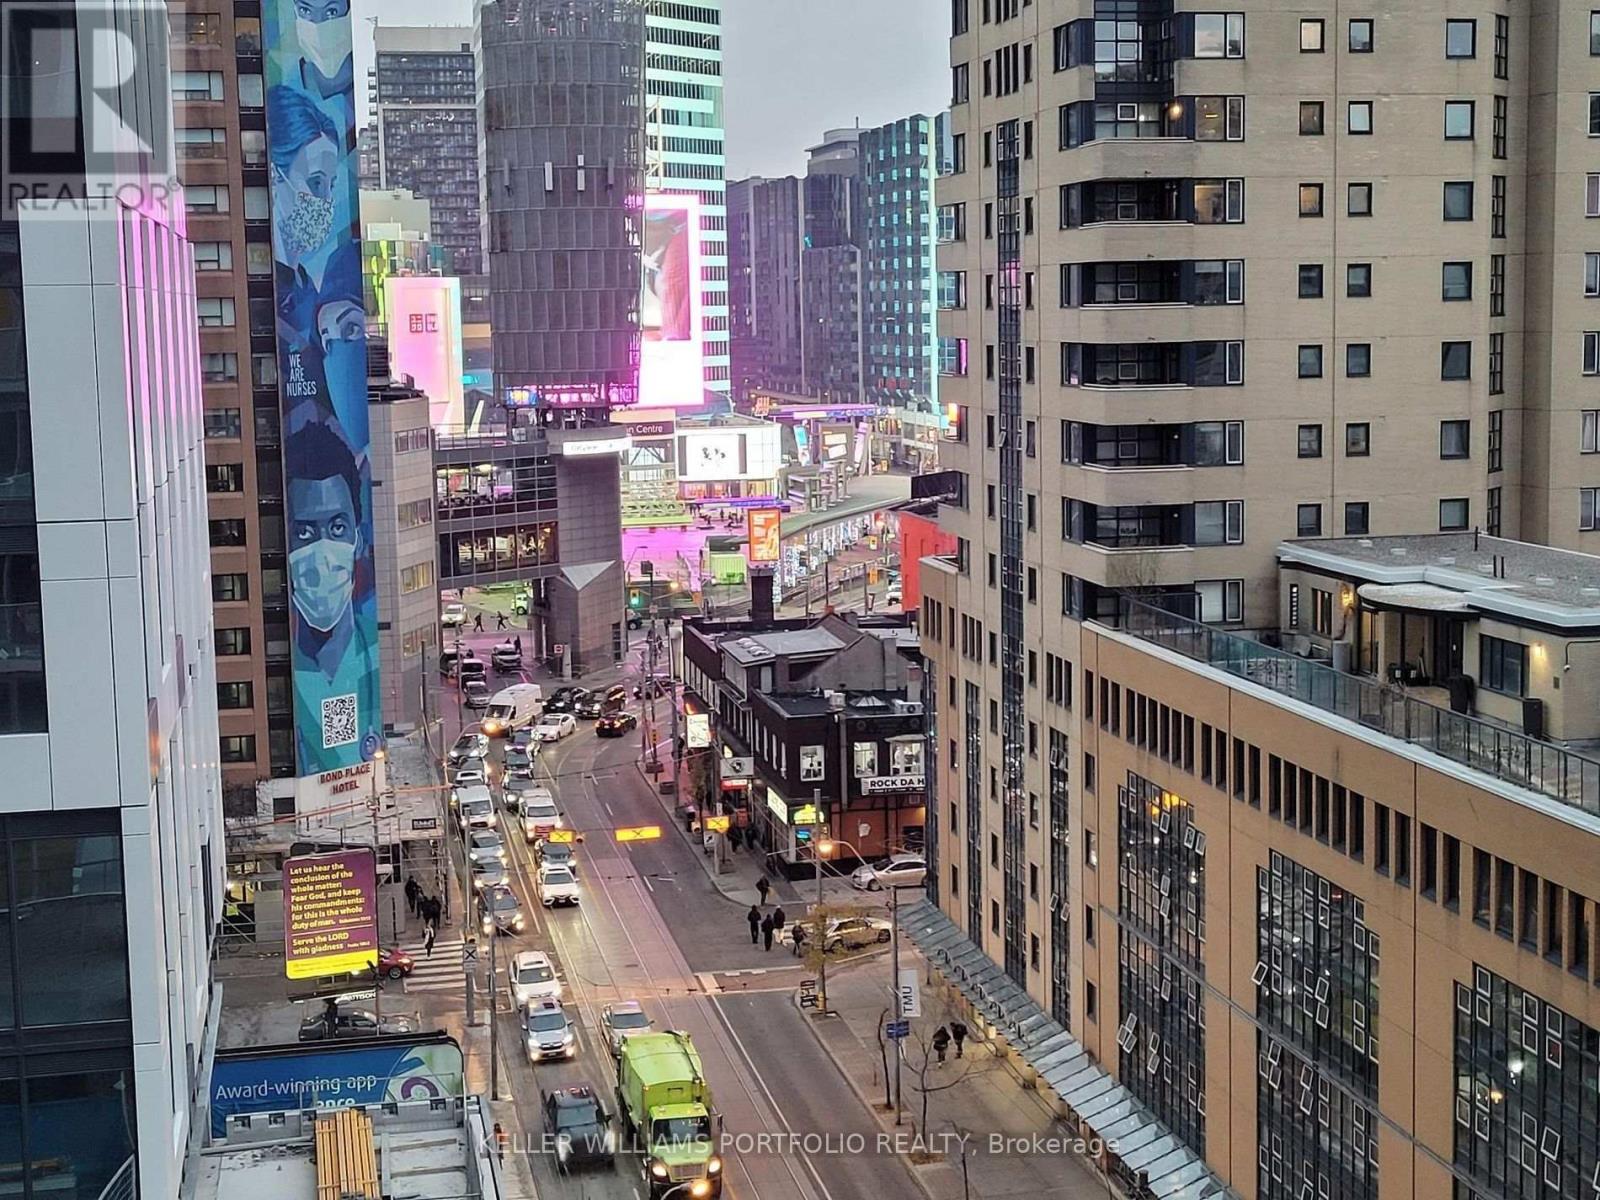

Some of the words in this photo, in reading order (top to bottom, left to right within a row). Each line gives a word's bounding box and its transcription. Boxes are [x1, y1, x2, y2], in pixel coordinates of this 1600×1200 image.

[289, 354, 301, 368] WE
[290, 367, 305, 382] ARE
[287, 381, 317, 397] NURSES
[636, 424, 664, 434] Centre
[320, 770, 343, 784] BOND
[345, 763, 371, 777] PLACE
[332, 780, 360, 795] HOTEL
[870, 779, 898, 787] ROCK
[900, 778, 915, 786] DA
[290, 867, 302, 875] Let
[313, 864, 330, 872] hear
[332, 862, 344, 870] the
[290, 873, 330, 884] conclusion
[331, 872, 340, 880] of
[340, 870, 353, 879] the
[291, 885, 314, 893] whole
[291, 894, 307, 902] Fear
[328, 890, 342, 898] and
[343, 888, 361, 898] keep
[291, 903, 302, 912] his
[292, 912, 303, 921] for
[304, 911, 318, 919] this
[326, 908, 339, 916] the
[340, 906, 363, 915] whole
[292, 921, 309, 931] duty
[309, 919, 318, 927] of
[293, 937, 314, 946] Serve
[315, 935, 327, 943] the
[328, 932, 349, 942] LORD
[293, 945, 310, 955] with
[311, 943, 344, 954] gladness
[902, 986, 913, 1013] TMU
[215, 1077, 341, 1100] Award-winning
[346, 1075, 377, 1093] app
